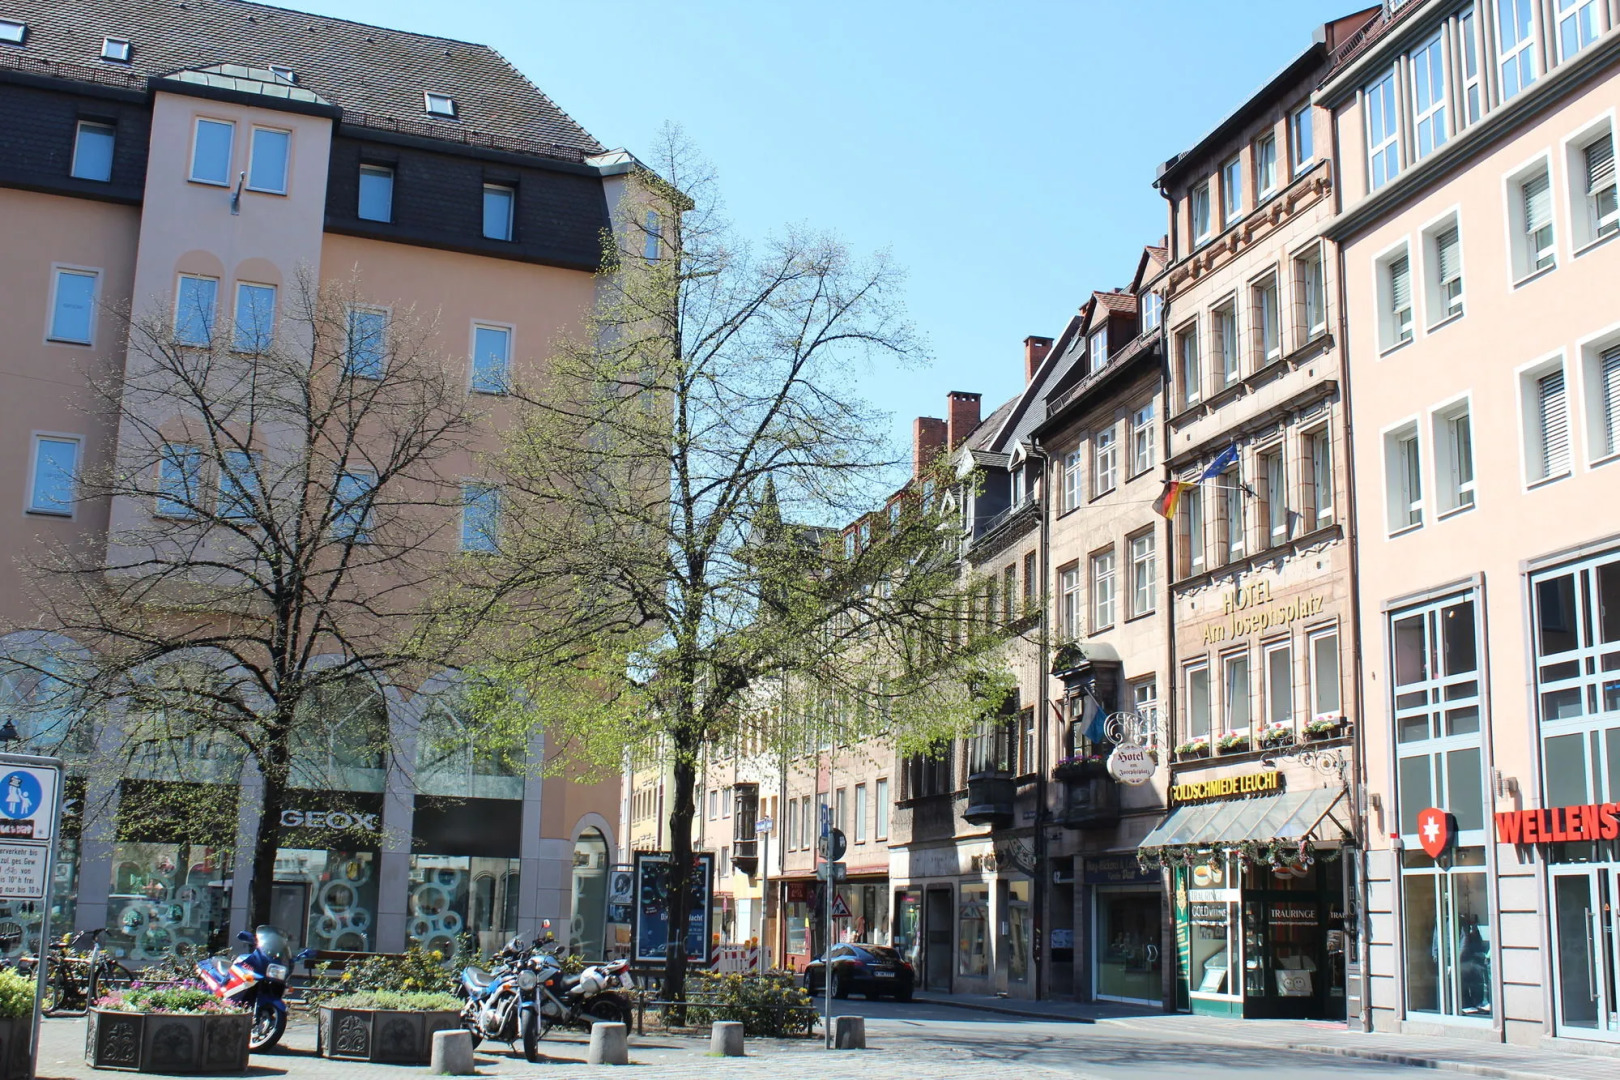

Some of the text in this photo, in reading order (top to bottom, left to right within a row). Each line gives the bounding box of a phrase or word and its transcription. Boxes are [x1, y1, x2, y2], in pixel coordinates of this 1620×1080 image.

[1223, 580, 1273, 615] HOTEL
[1203, 593, 1324, 646] Am Josephsplatz
[1118, 751, 1144, 762] Hotel
[1171, 771, 1278, 802] GOLDSCHMIEDE LEUCHT
[279, 809, 377, 831] GEOX
[1494, 802, 1620, 844] WELLENS
[1271, 909, 1315, 918] TRAURINGE
